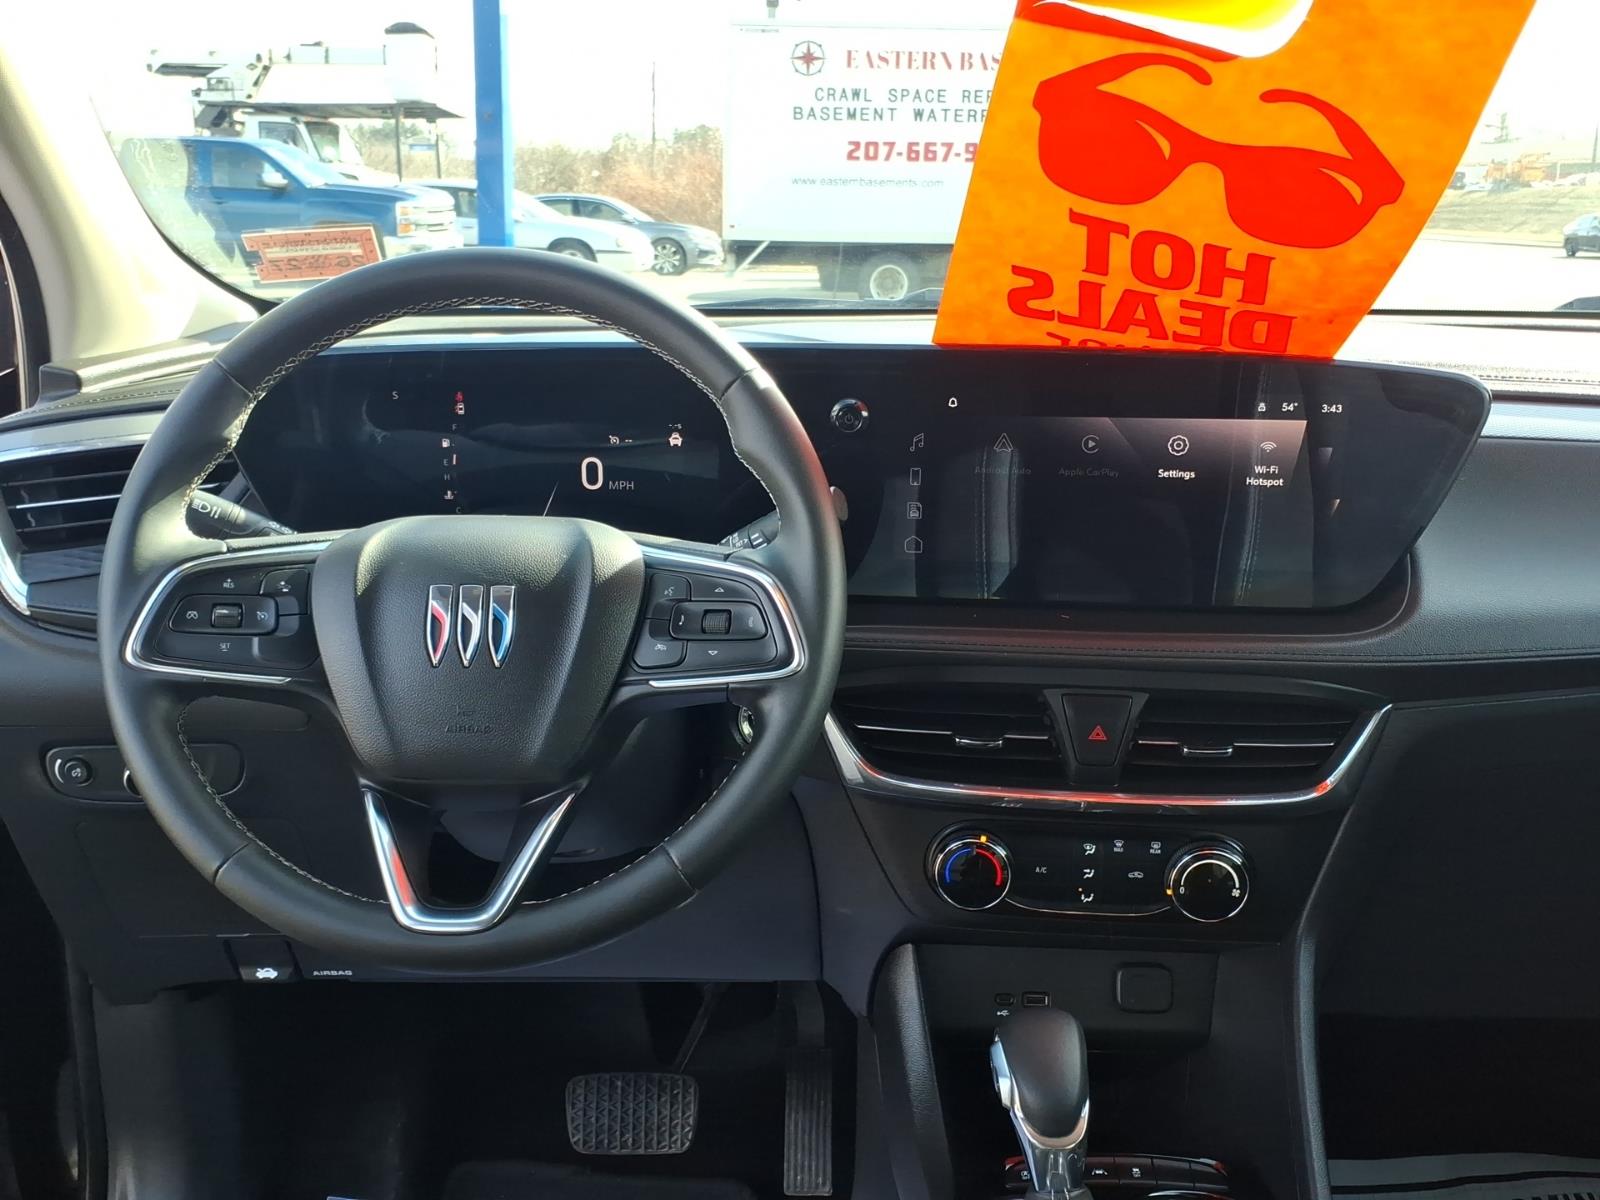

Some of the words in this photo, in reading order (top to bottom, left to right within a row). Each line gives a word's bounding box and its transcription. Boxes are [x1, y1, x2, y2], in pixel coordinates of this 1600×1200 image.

[846, 50, 952, 70] EASTERN
[815, 87, 872, 102] CRAWL
[888, 88, 947, 103] SPACE
[793, 106, 898, 122] BASEMENT
[846, 141, 978, 162] 207-667-9
[1321, 404, 1343, 413] 3:43
[581, 456, 603, 490] 0
[609, 481, 635, 490] MPH
[1158, 468, 1195, 480] Settings
[1254, 465, 1279, 474] Wi-Fi
[1246, 477, 1284, 487] Hotspot
